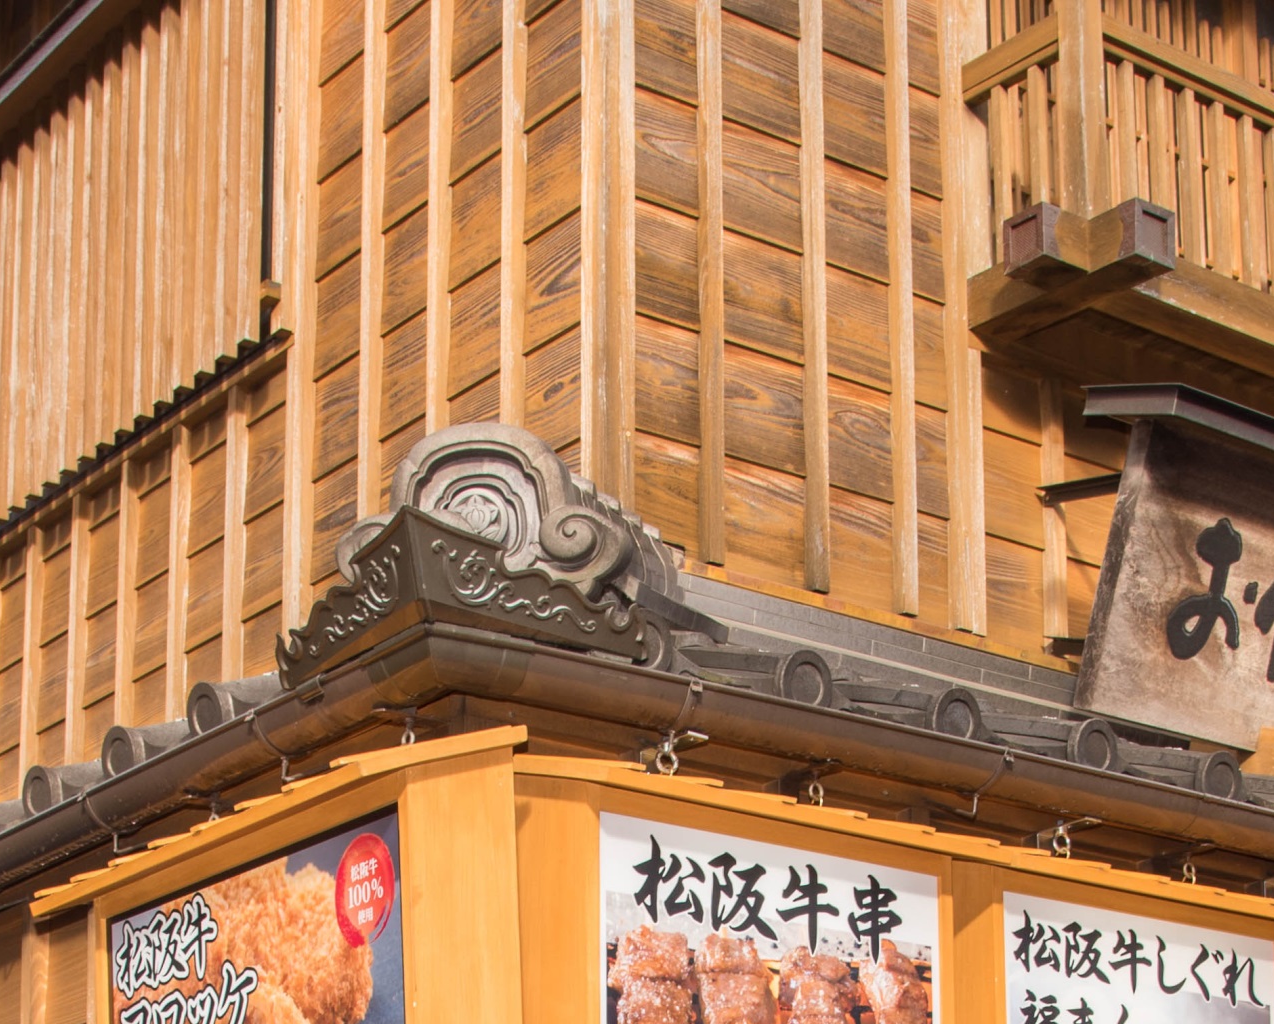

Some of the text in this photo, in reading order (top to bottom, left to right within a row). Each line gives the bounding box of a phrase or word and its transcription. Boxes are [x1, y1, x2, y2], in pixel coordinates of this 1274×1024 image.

[347, 879, 385, 911] 100%
[349, 859, 378, 882] 松阪牛
[634, 834, 903, 964] 松阪牛串
[117, 892, 219, 999] 松阪牛
[357, 906, 375, 926] 使用
[1012, 910, 1265, 1009] 松阪牛しぐれ
